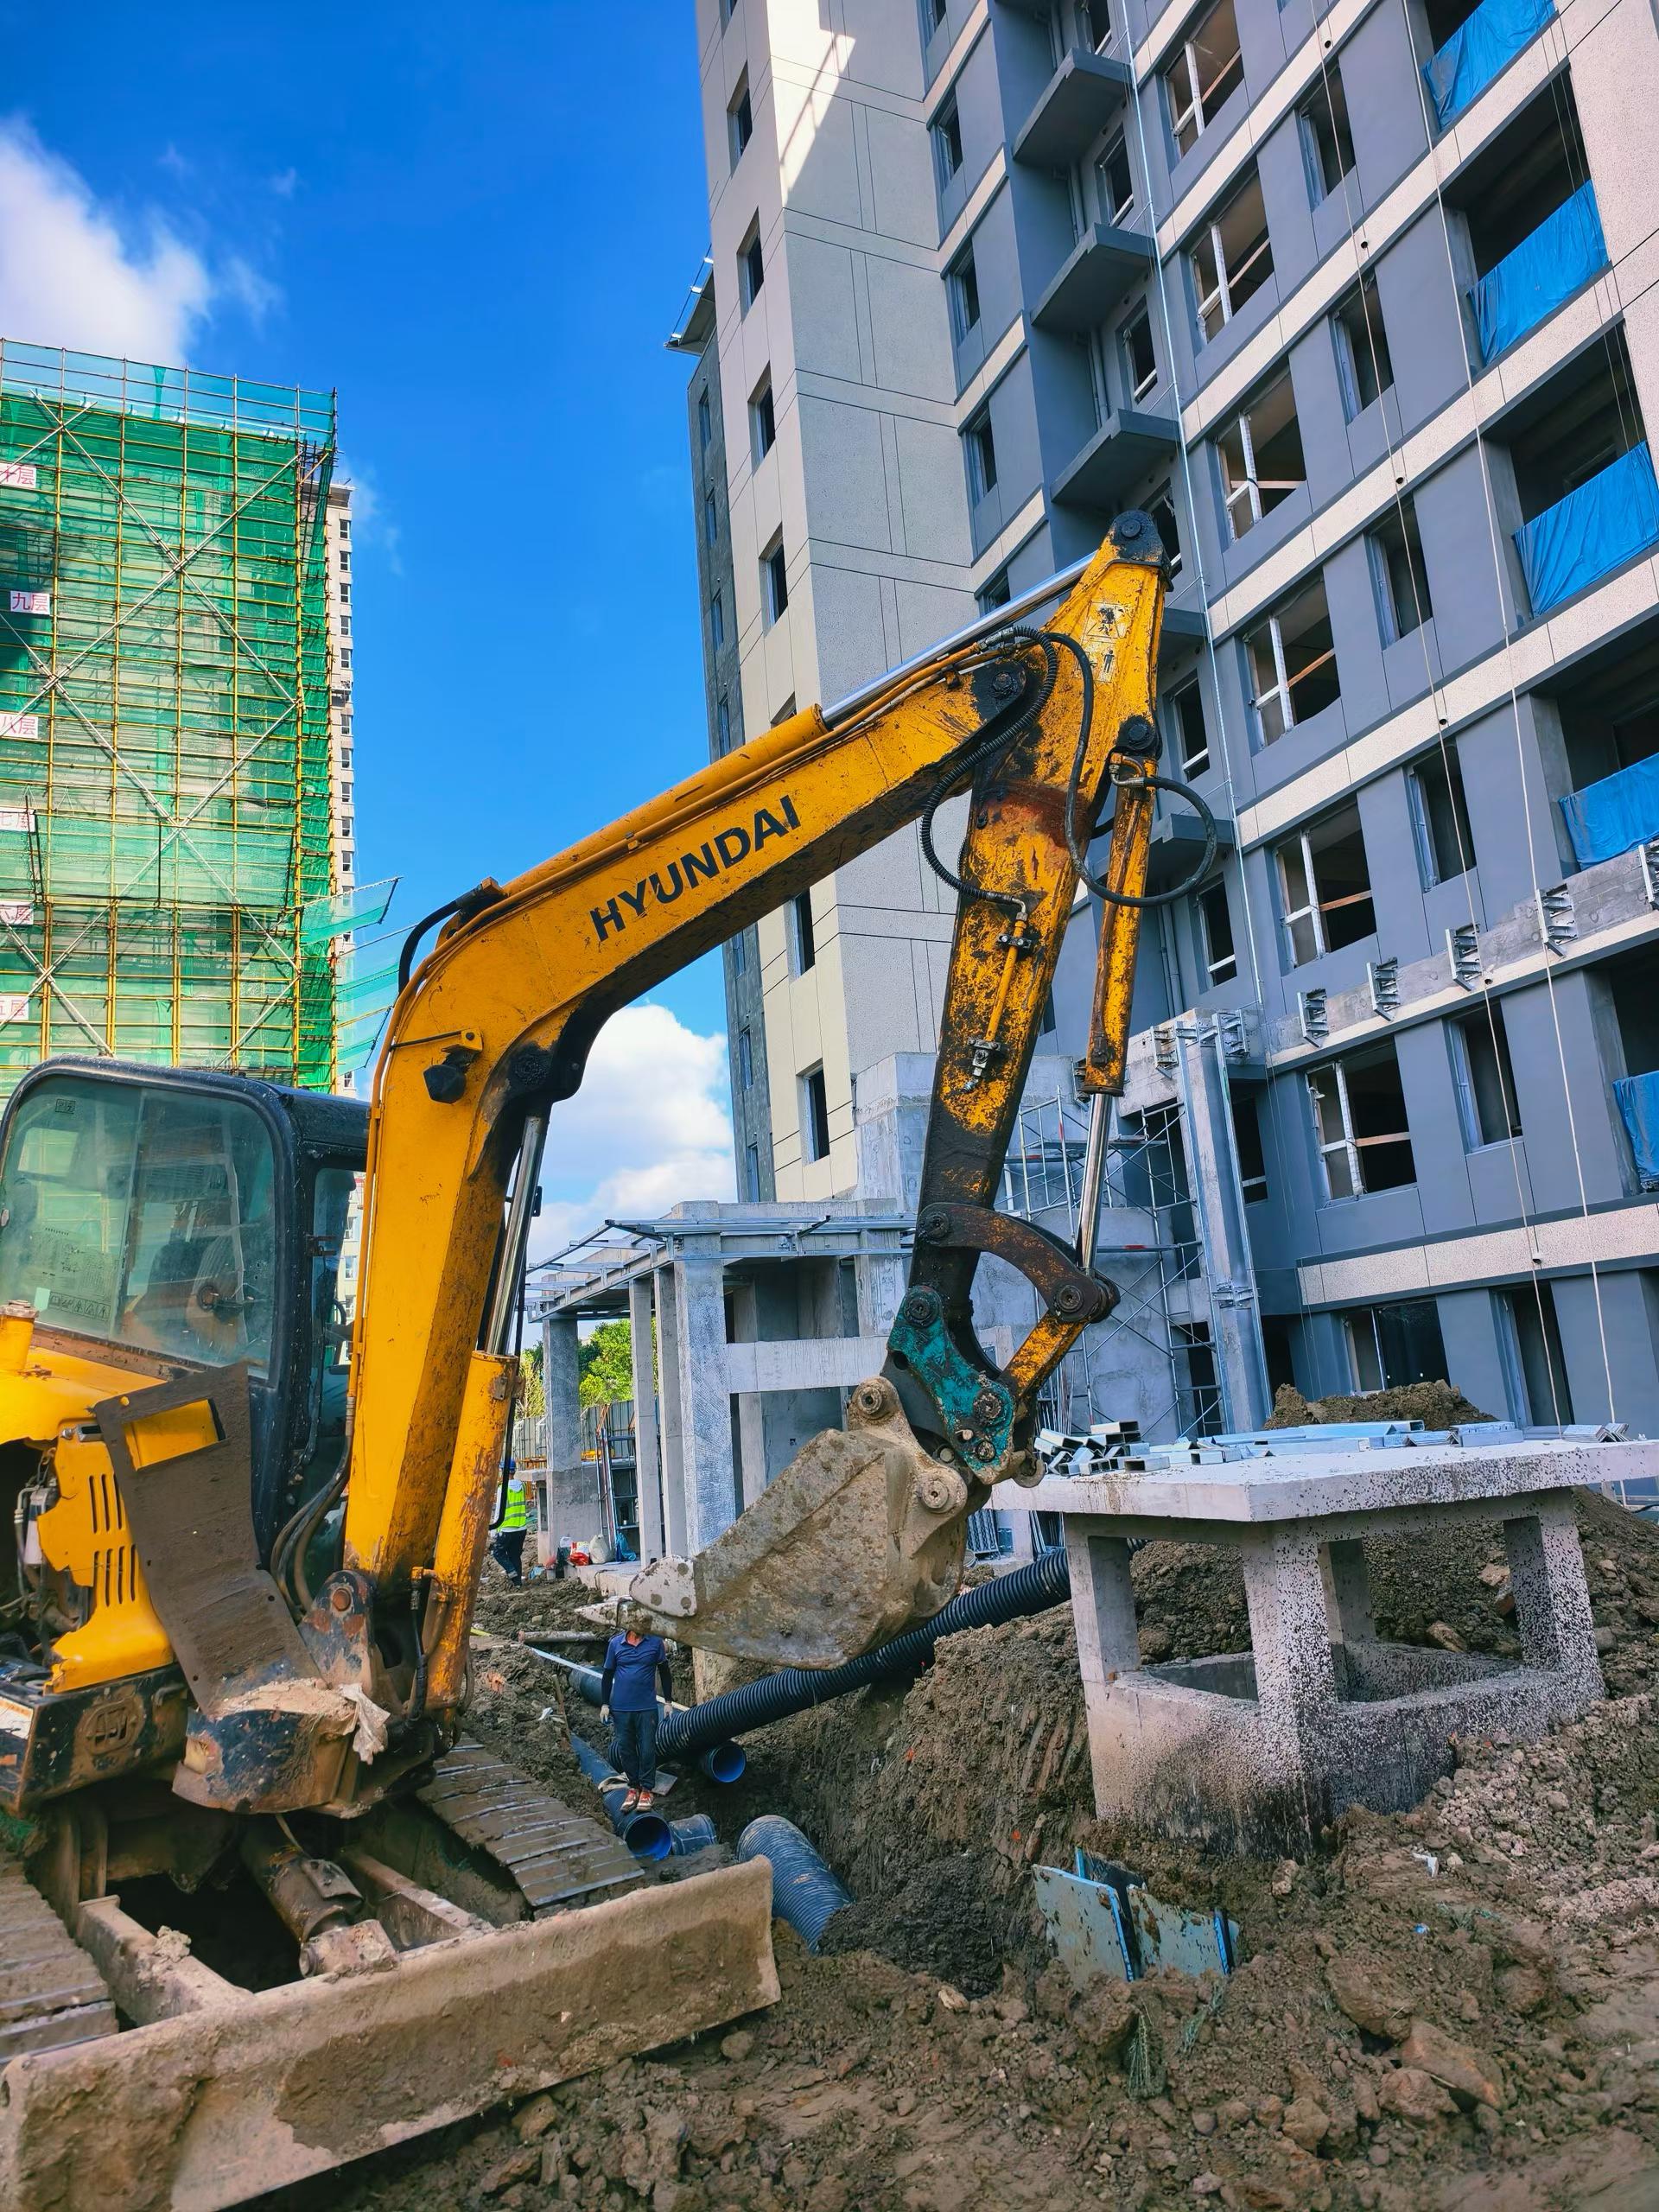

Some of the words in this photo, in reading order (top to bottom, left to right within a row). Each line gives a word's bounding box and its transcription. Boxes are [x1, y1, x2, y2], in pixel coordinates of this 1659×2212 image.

[12, 592, 48, 613] 九层
[1, 715, 36, 736] 八层
[589, 794, 802, 942] HYUNDAI
